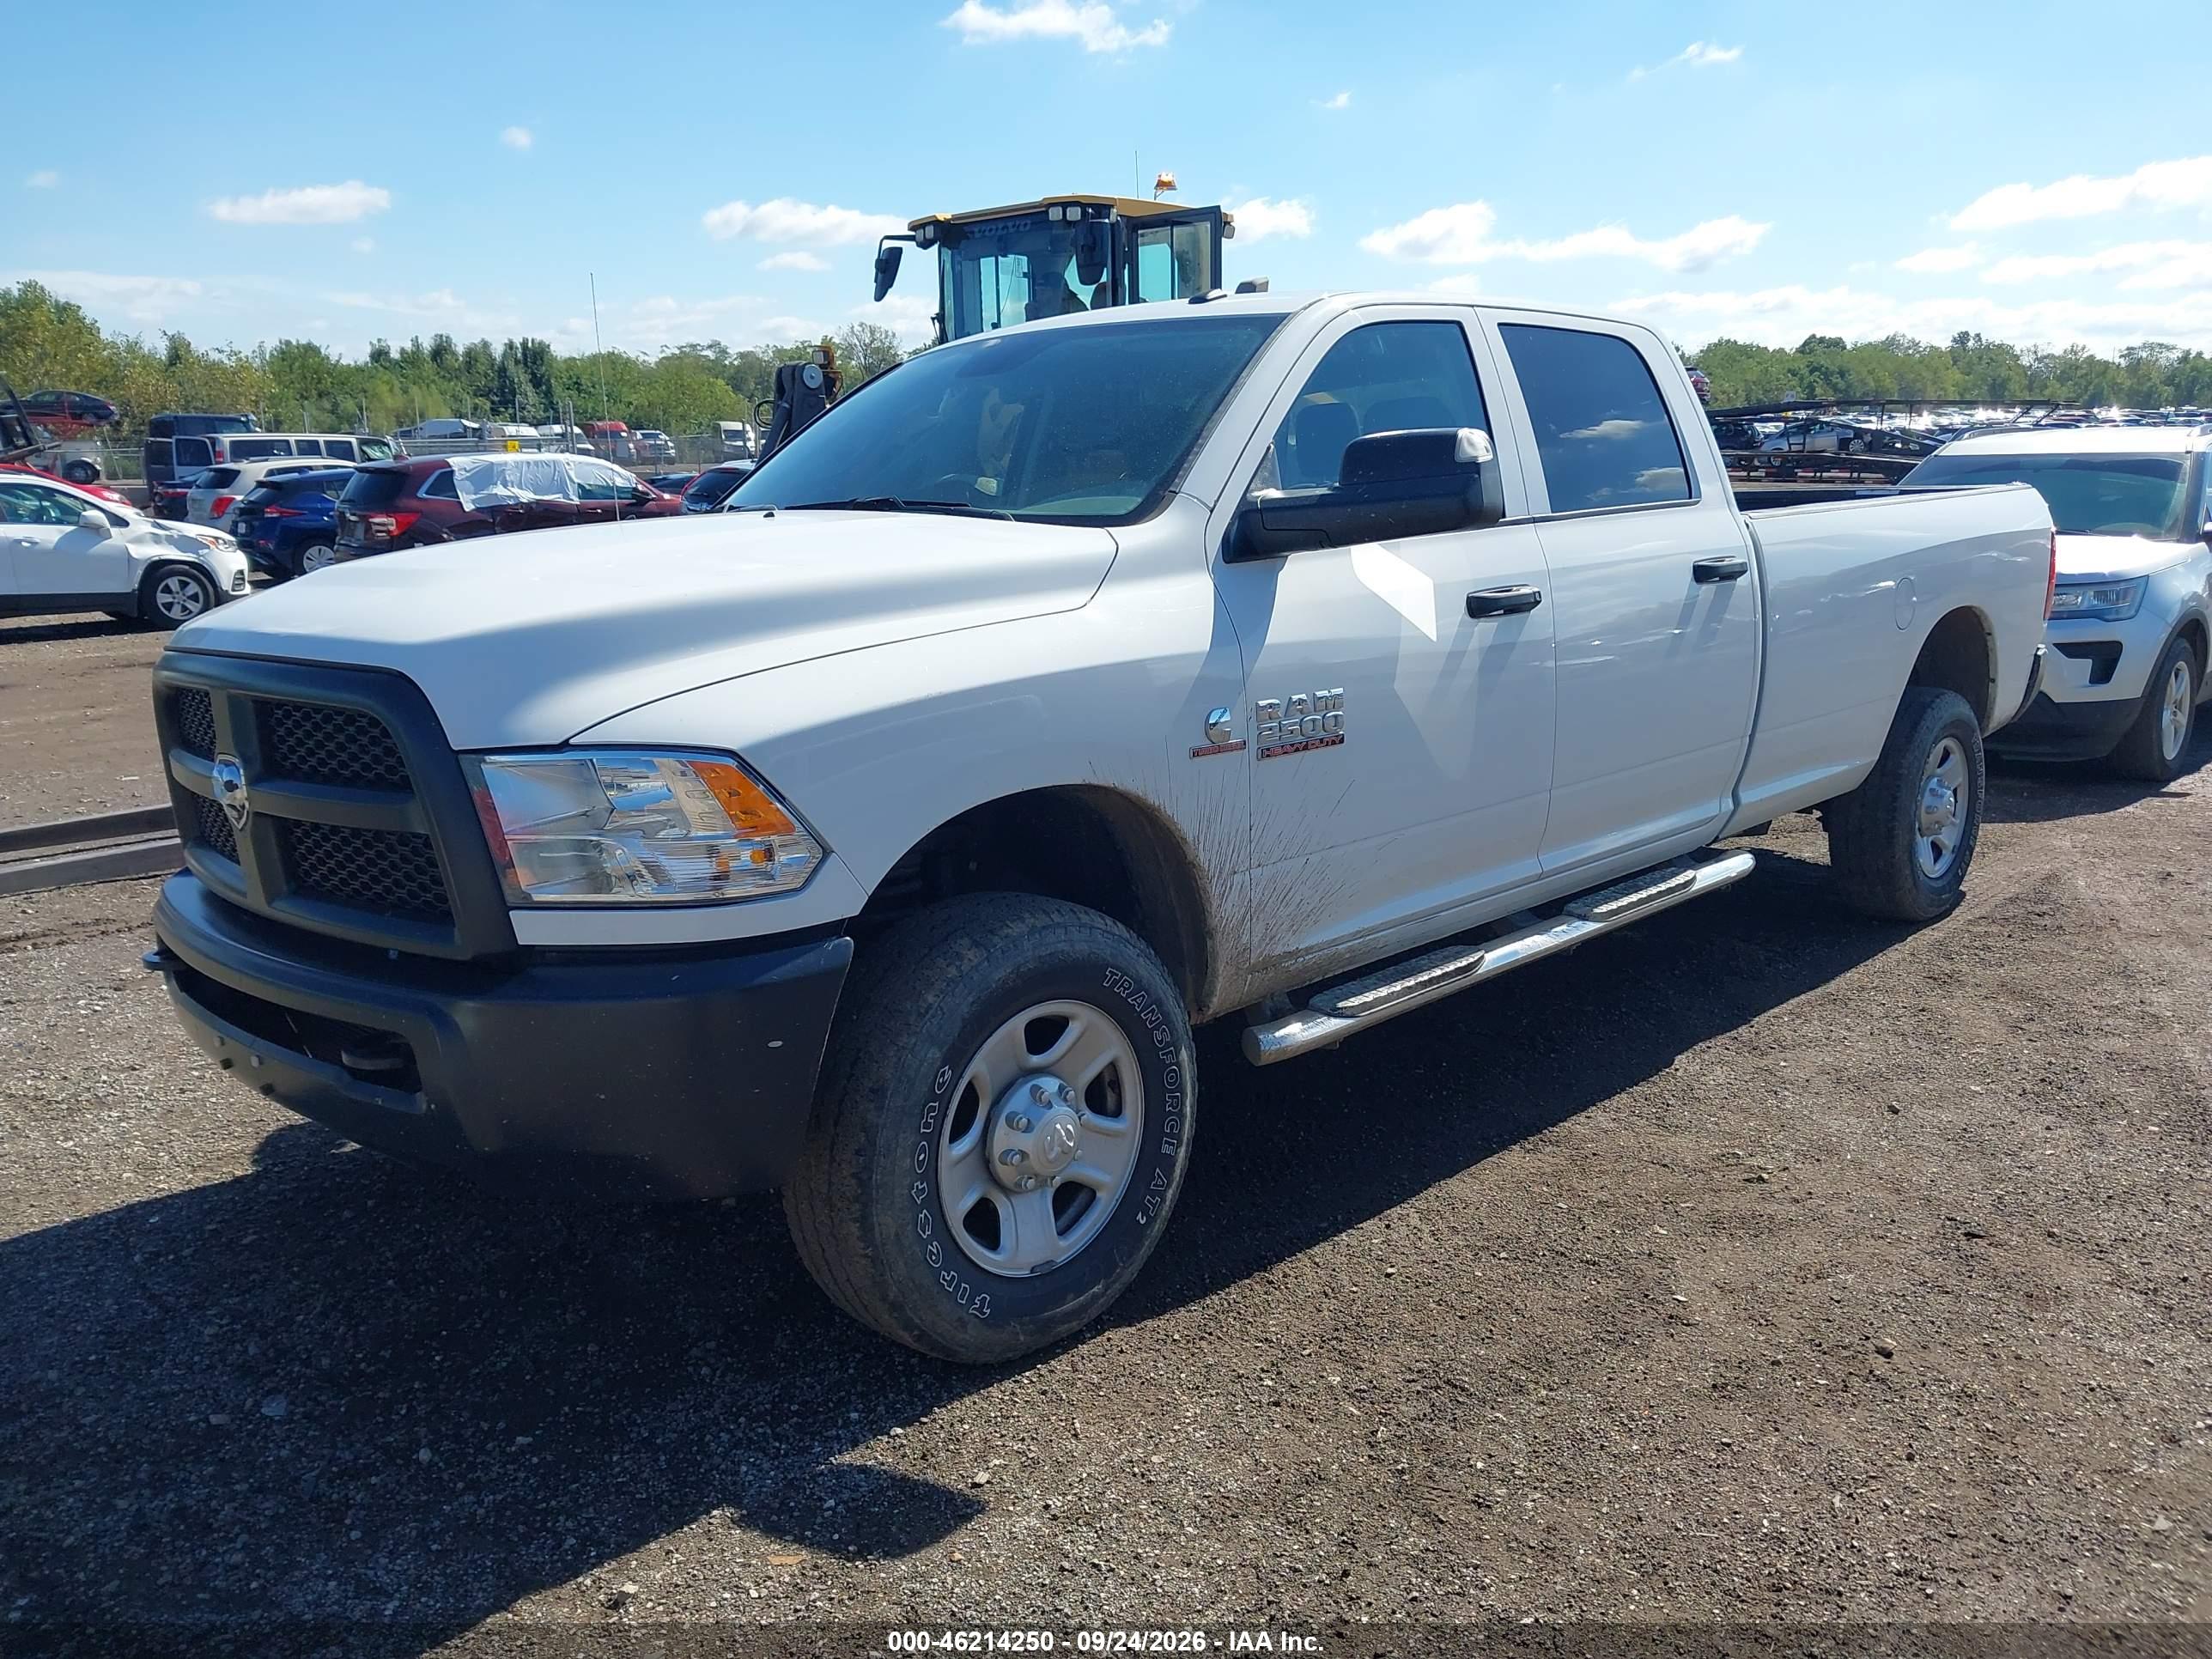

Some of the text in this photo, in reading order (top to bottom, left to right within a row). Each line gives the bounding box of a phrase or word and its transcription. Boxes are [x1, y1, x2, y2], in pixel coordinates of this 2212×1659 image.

[1256, 687, 1344, 722] RAM
[1257, 711, 1345, 745] 2500
[1263, 736, 1342, 757] HEAVY DUTY
[1103, 968, 1182, 1156] TRANSFORCE
